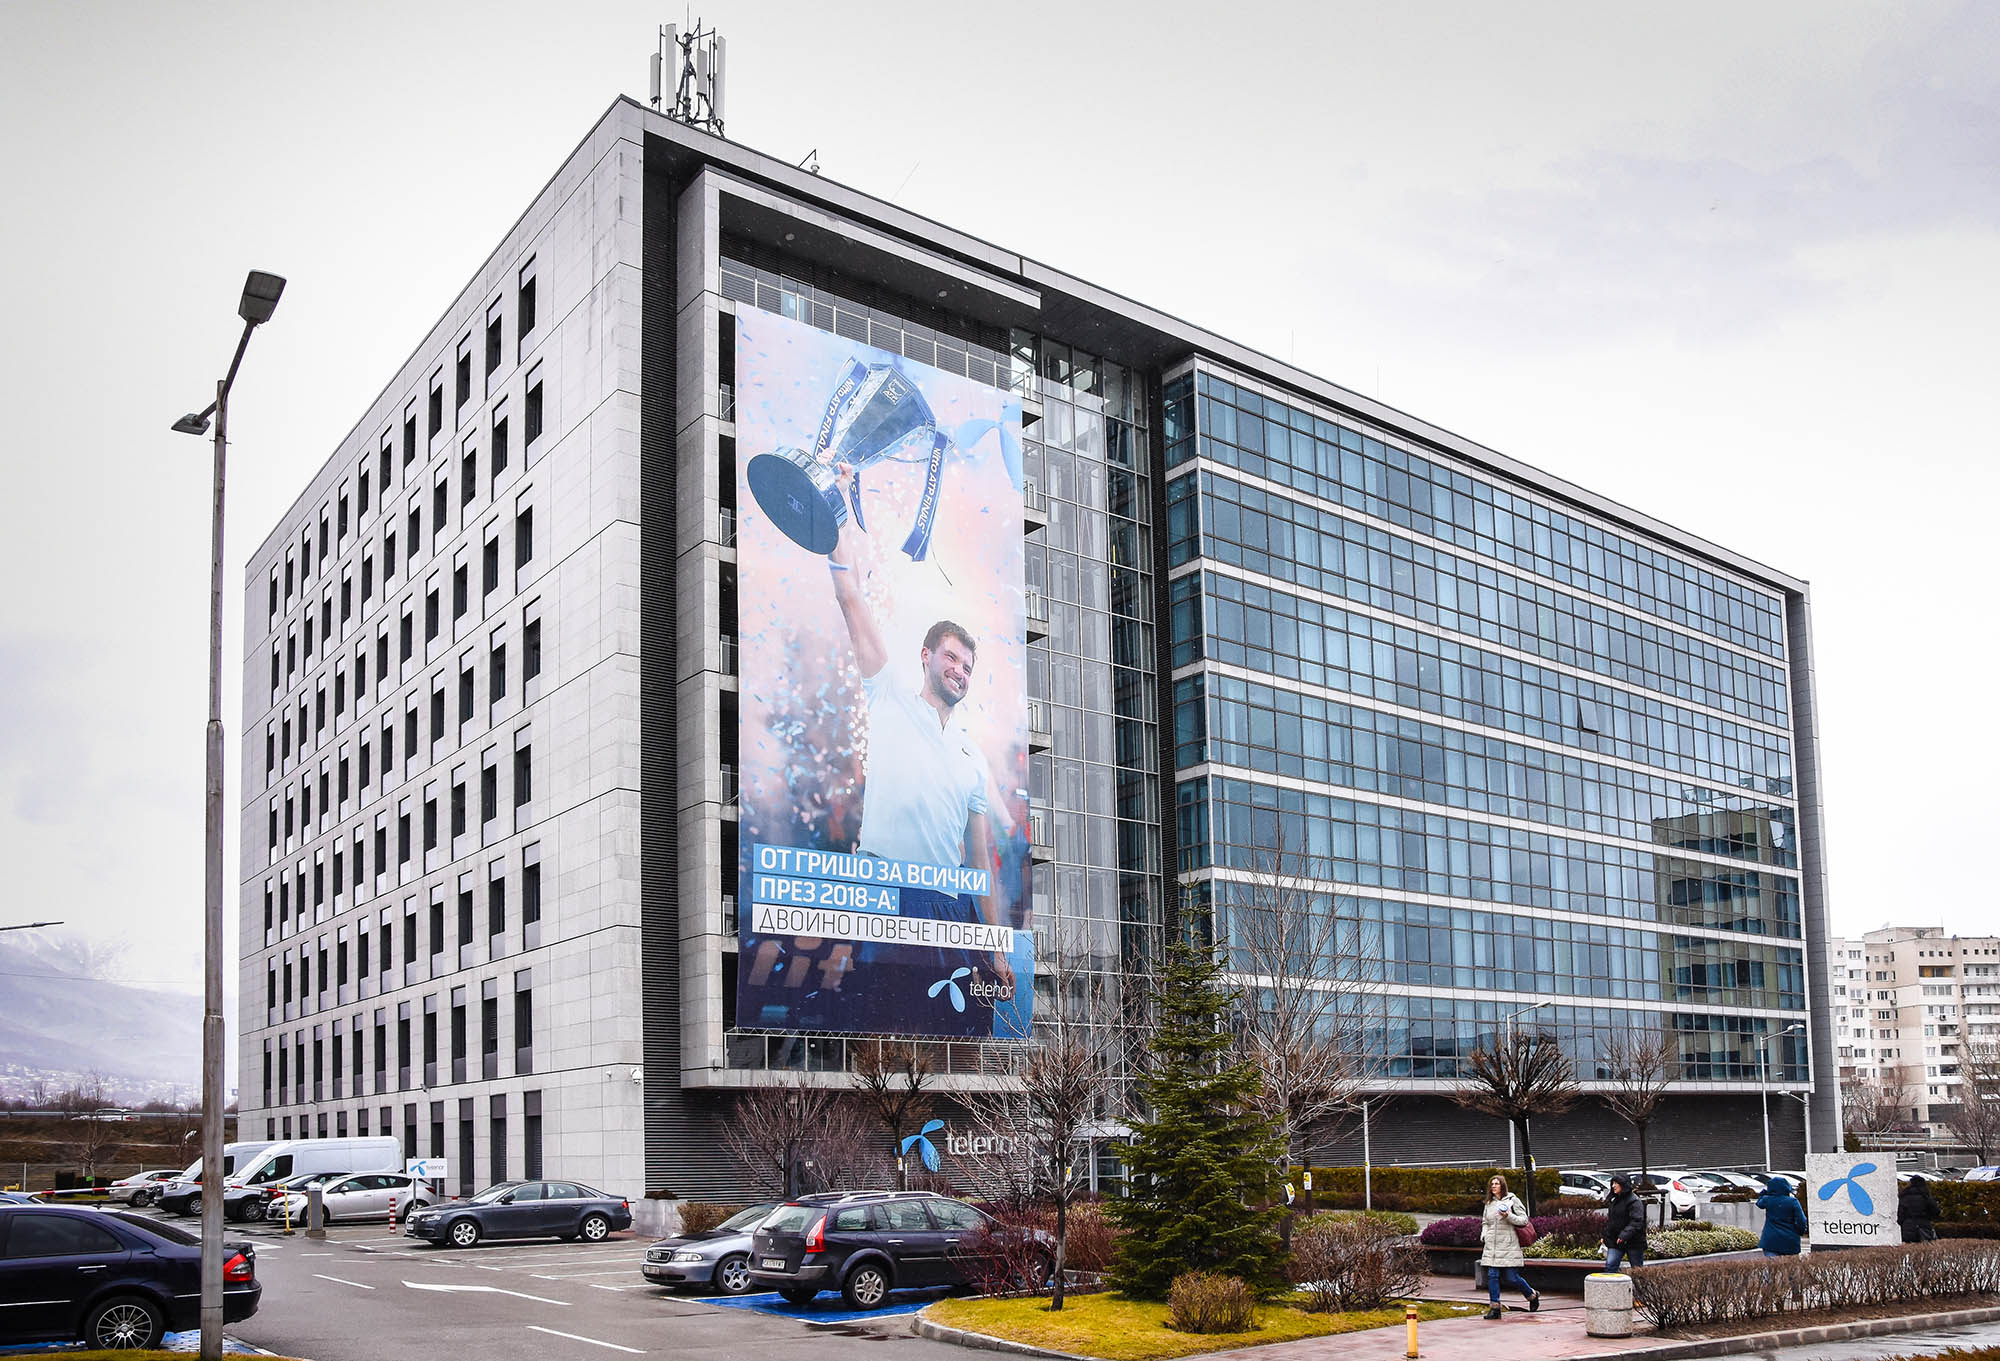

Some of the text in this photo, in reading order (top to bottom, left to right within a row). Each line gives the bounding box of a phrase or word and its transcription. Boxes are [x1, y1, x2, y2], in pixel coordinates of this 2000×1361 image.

[829, 395, 841, 416] ATP
[928, 473, 937, 496] ATP
[760, 847, 987, 892] ОТ ГРИШО ЗА ВСИЧКИ
[760, 877, 816, 903] ПРЕЗ
[856, 914, 931, 942] ПОВЕЧЕ
[936, 923, 1010, 950] ПОБЕДИ
[969, 980, 1014, 999] telenor
[1823, 1218, 1880, 1235] telenor
